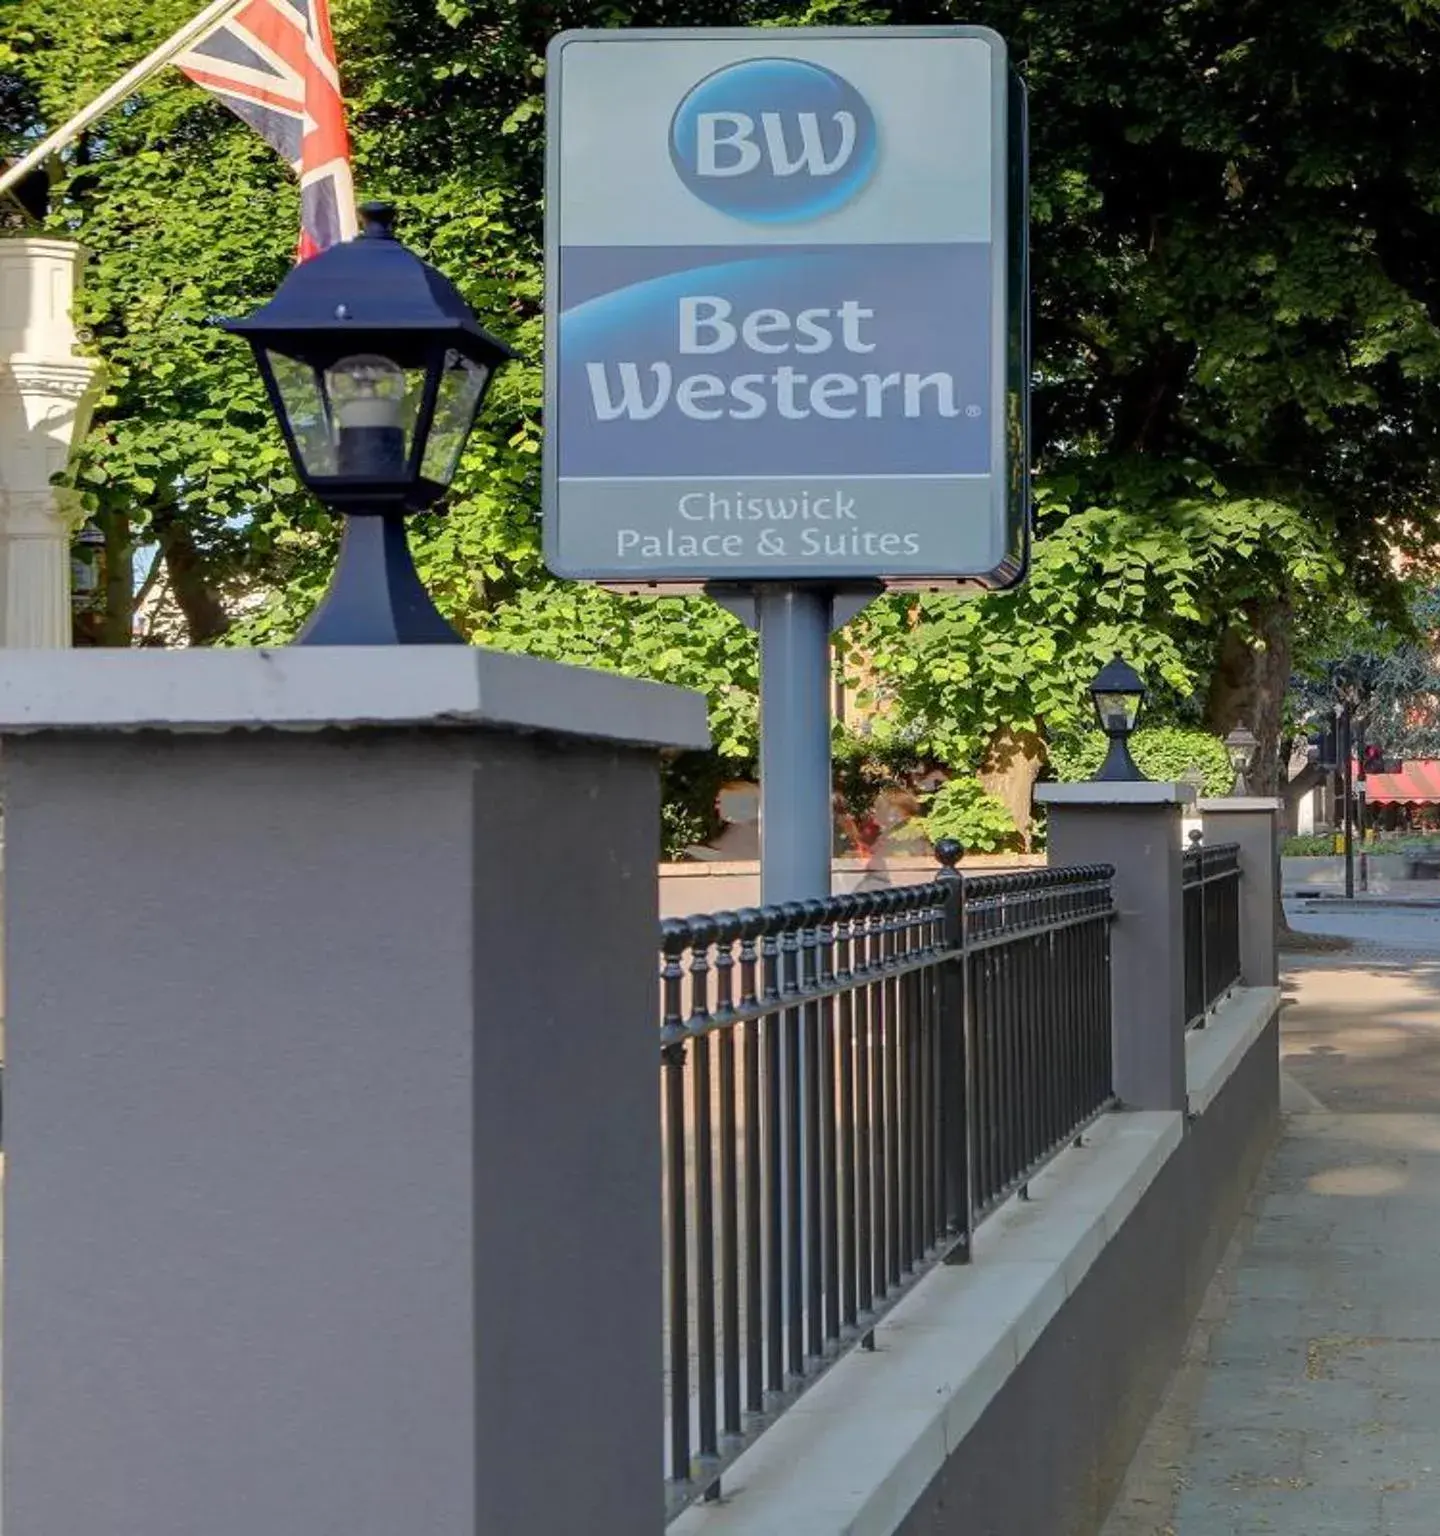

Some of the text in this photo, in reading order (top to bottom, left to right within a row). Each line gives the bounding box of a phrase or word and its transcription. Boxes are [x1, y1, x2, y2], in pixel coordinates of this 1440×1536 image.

[696, 110, 857, 177] BW
[678, 295, 877, 355] Best
[677, 490, 858, 522] Chiswick
[616, 526, 921, 558] Palace & Suites
